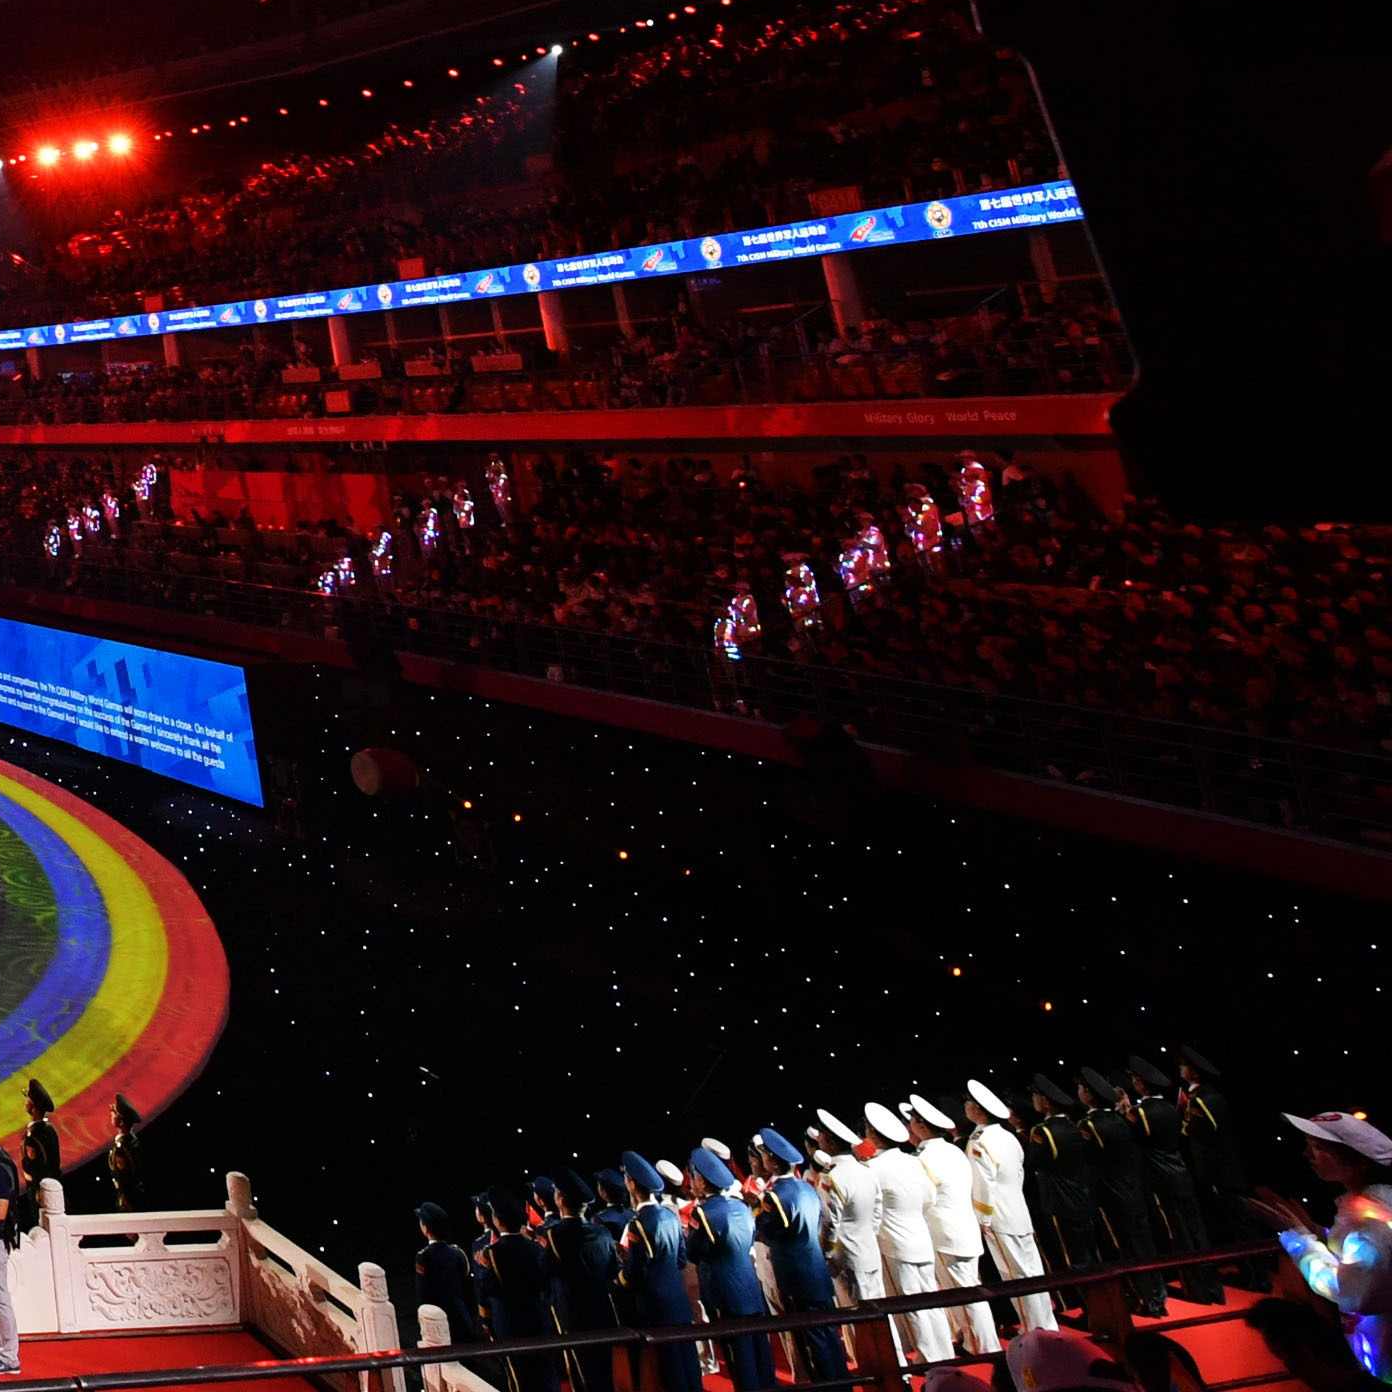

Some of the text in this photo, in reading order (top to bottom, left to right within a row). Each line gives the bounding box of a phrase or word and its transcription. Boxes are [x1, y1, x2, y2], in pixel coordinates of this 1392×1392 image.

[979, 186, 1077, 211] 第七届世界军人运动
[972, 221, 988, 230] 7th
[988, 217, 1011, 228] CISM
[1011, 213, 1047, 225] Military
[1047, 208, 1076, 219] World
[767, 247, 793, 258] Military
[794, 244, 815, 255] World
[816, 242, 841, 252] Games
[865, 410, 1017, 425] Military Glory World Peace
